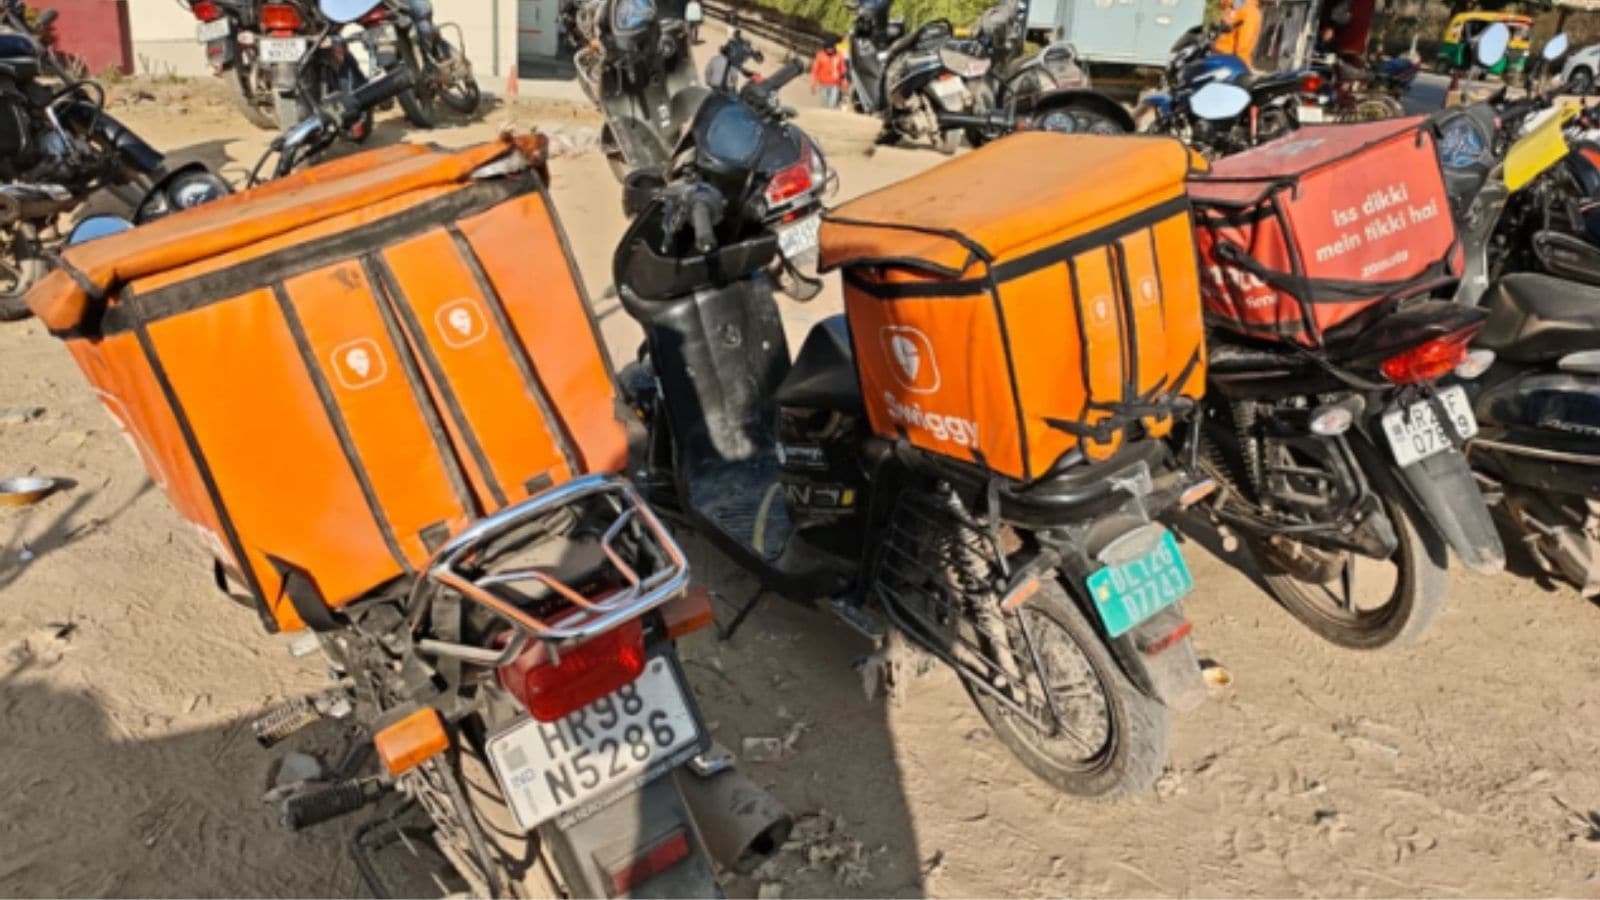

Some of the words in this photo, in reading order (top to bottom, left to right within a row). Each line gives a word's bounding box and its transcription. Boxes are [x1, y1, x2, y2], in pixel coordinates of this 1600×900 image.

[1316, 233, 1360, 262] mein
[1408, 197, 1438, 224] hai
[1331, 207, 1358, 228] iss
[1362, 181, 1408, 215] dikki
[884, 391, 979, 450] Swiggy
[538, 683, 643, 759] HR98
[543, 710, 675, 806] N5286
